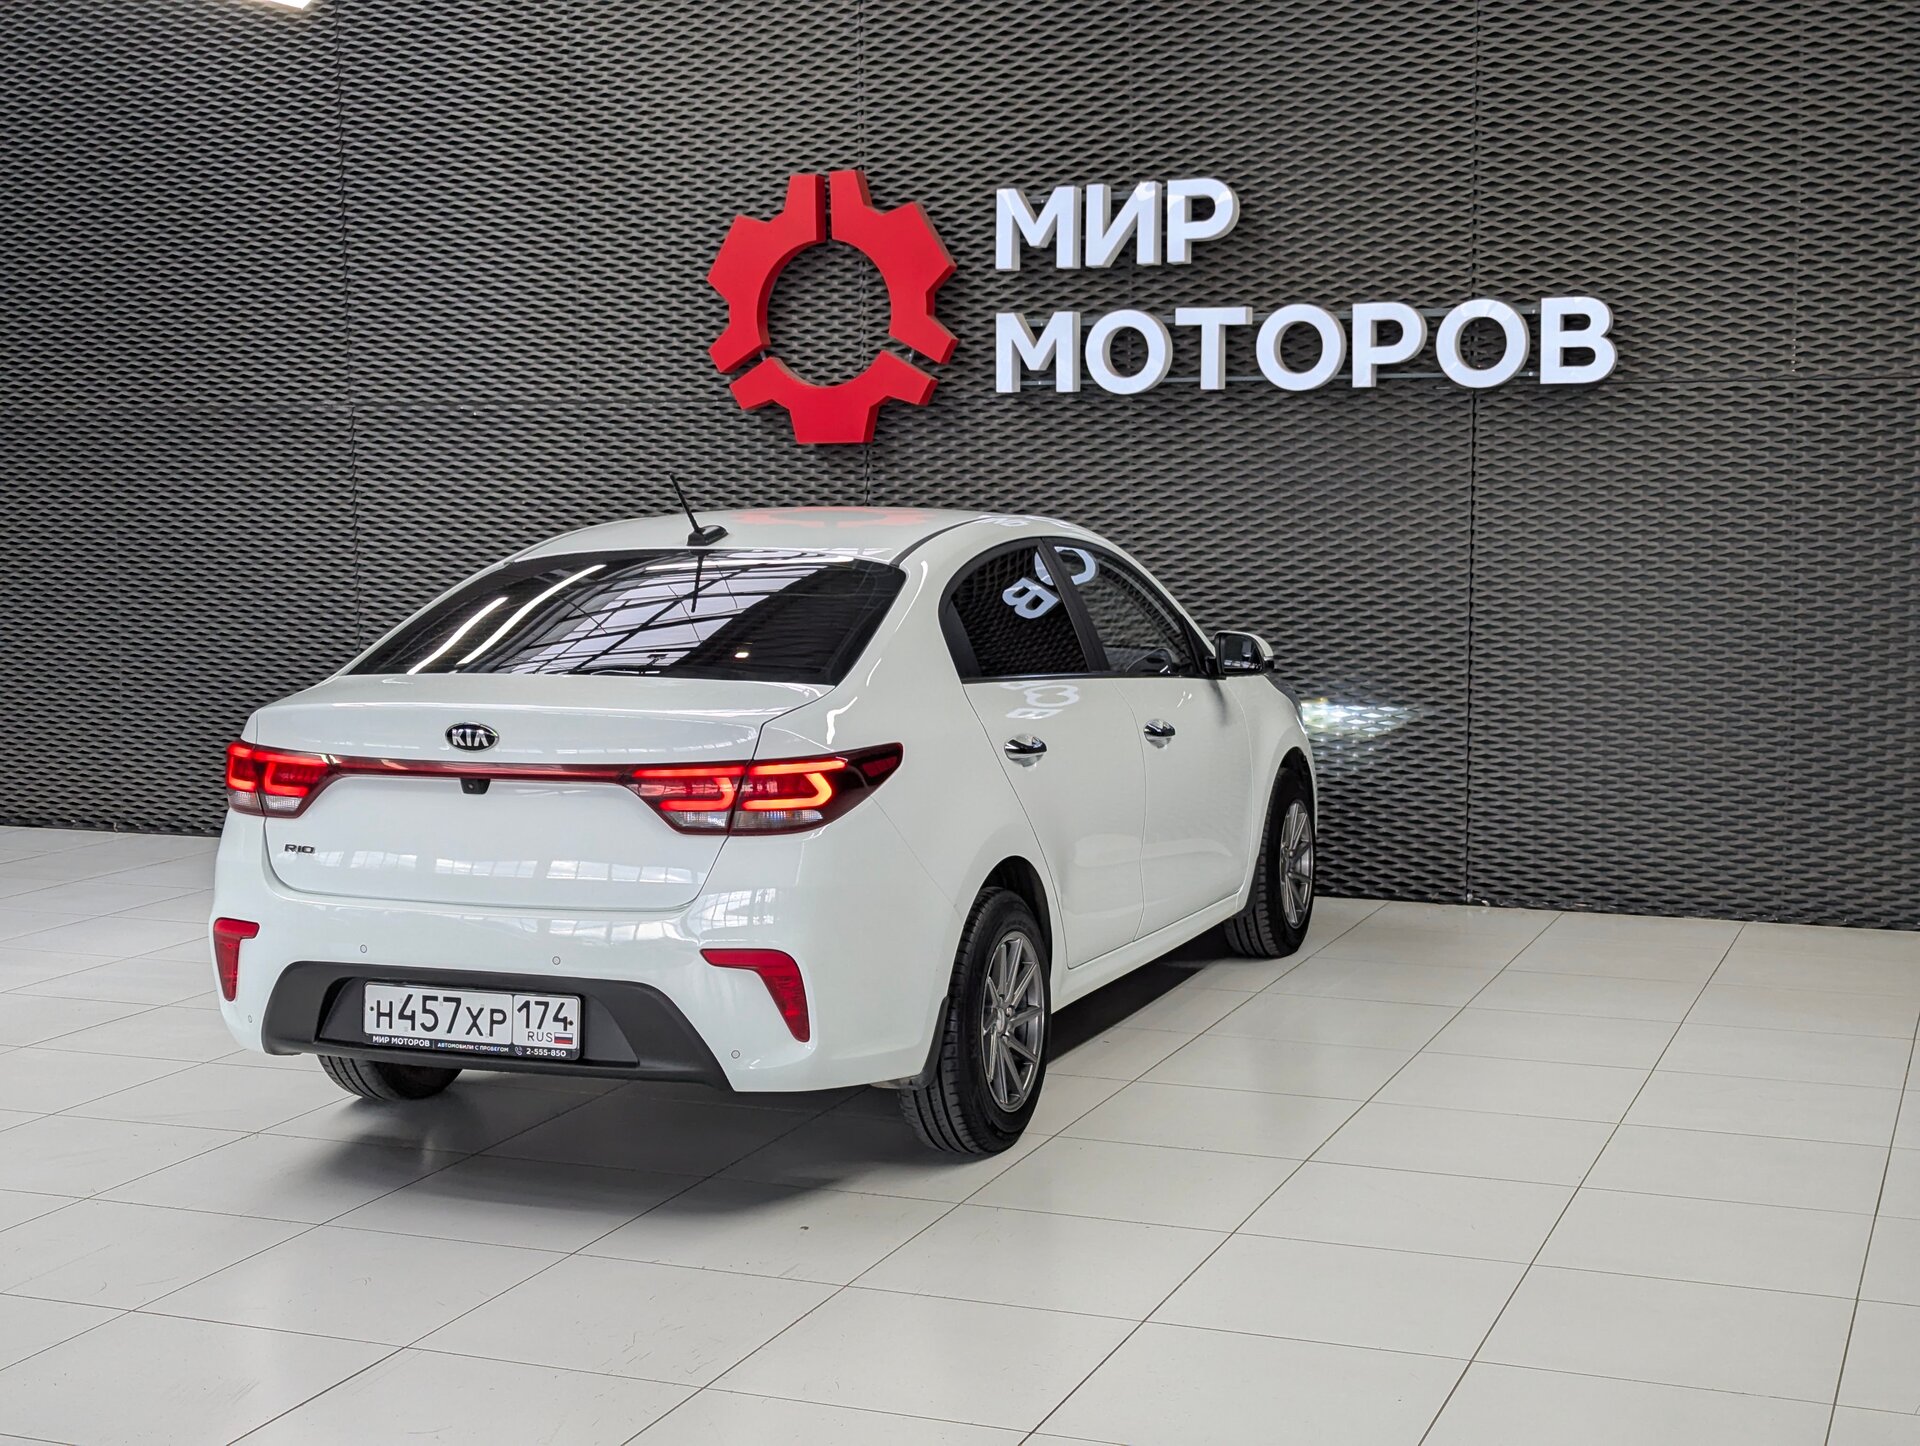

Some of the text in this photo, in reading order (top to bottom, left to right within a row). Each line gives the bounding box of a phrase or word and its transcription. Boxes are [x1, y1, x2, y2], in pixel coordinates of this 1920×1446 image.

[995, 178, 1241, 271] МИР
[995, 296, 1618, 395] МОТОРОВ
[451, 728, 489, 747] KIA
[284, 843, 316, 854] RIO
[516, 1000, 568, 1032] 174
[372, 1035, 390, 1045] МИР
[391, 1037, 431, 1048] МОТОРОВ
[437, 1042, 474, 1050] АВТОМОБИЛИ
[479, 1045, 509, 1053] ПРОБЕГОМ
[526, 1047, 567, 1058] 2-555-850
[527, 1031, 553, 1043] RUS
